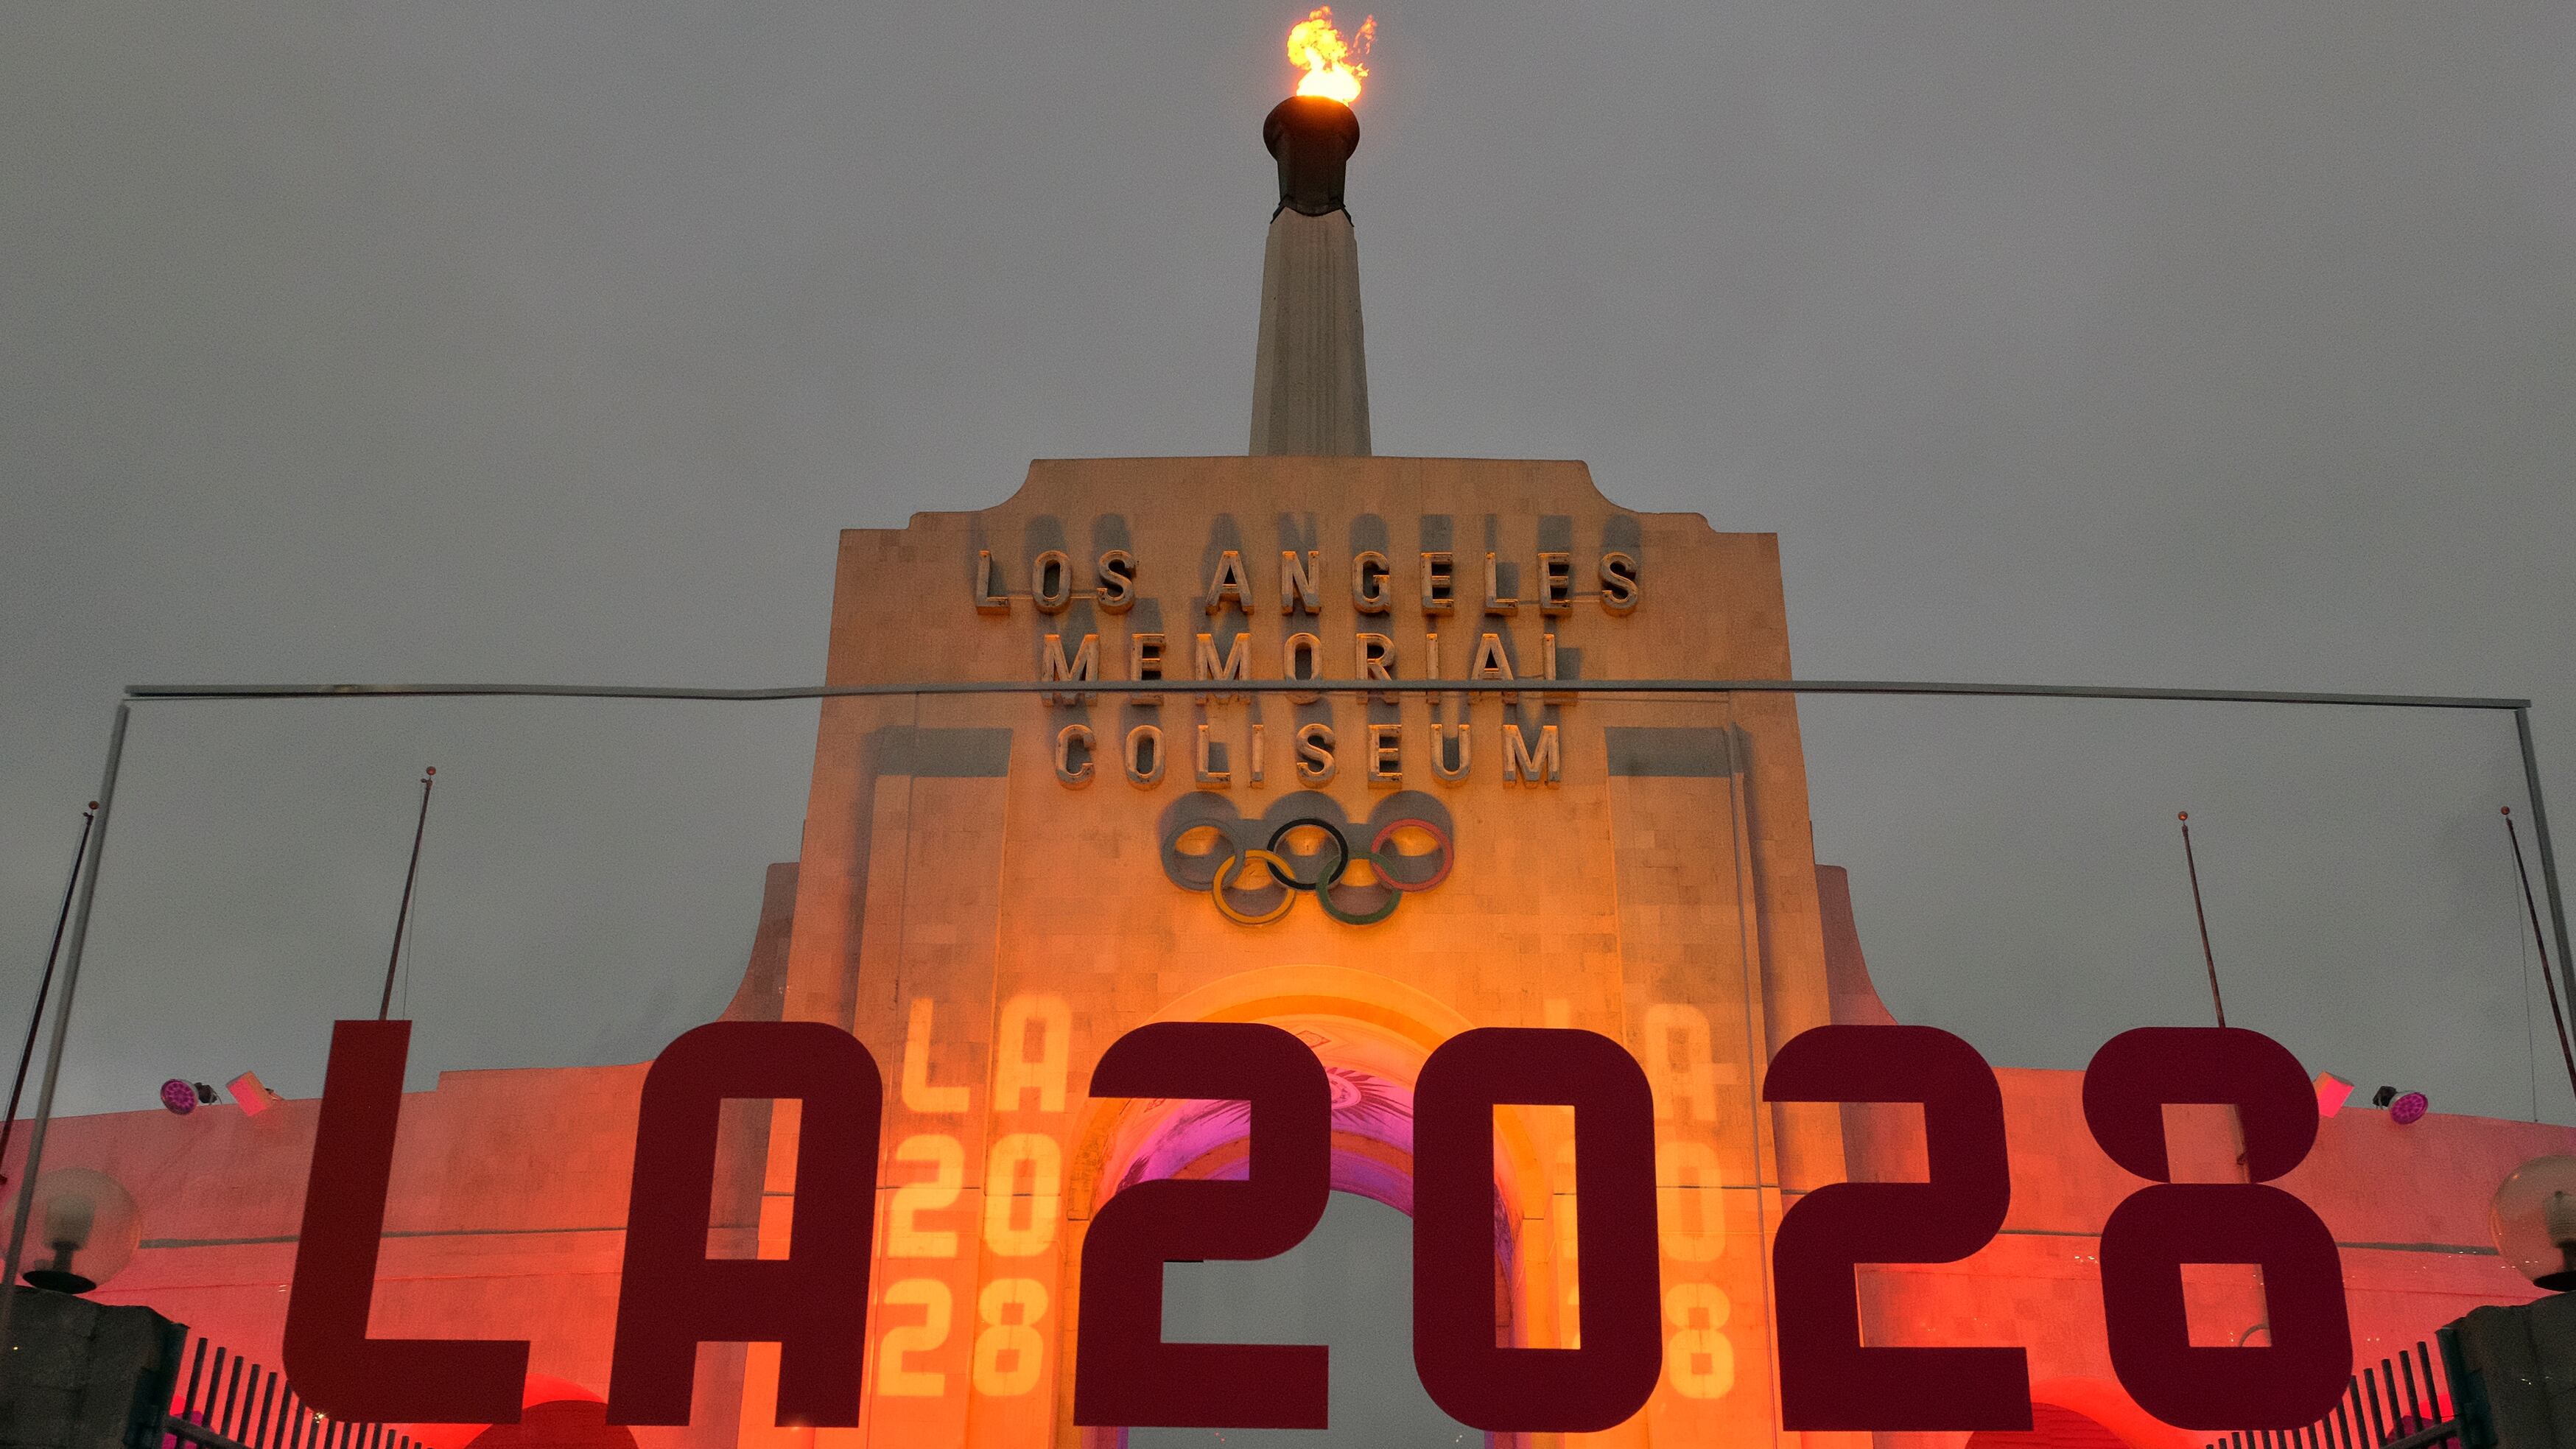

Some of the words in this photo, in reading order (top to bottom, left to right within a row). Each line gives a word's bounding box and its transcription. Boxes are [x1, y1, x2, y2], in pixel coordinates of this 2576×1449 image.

[976, 550, 1135, 614] LOS
[1206, 550, 1639, 616] ANGELES
[1040, 633, 1577, 705] MEMORIAL
[1055, 723, 1561, 788] COLISEUM
[900, 994, 1073, 1112] LA
[282, 1020, 882, 1428] LA
[1073, 1021, 2353, 1433] 2028
[887, 1132, 1062, 1259] 20
[876, 1277, 1050, 1397] 28
